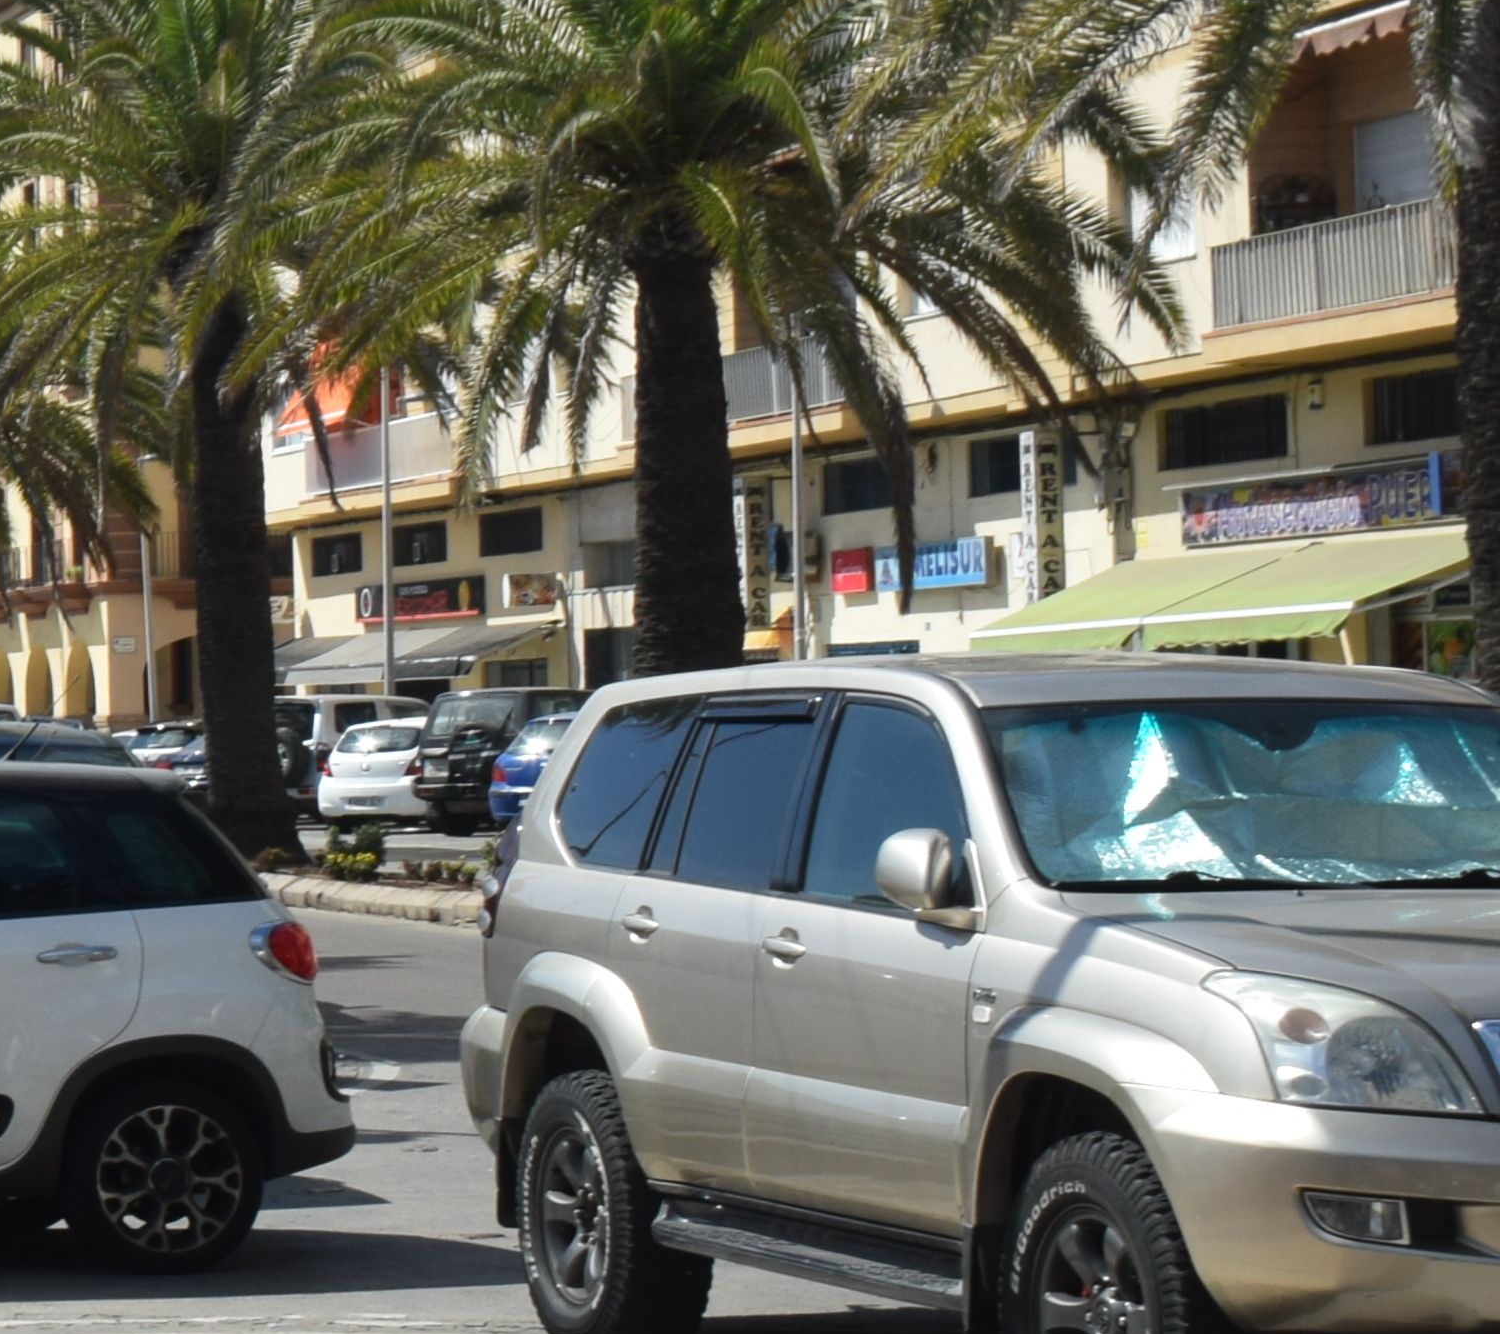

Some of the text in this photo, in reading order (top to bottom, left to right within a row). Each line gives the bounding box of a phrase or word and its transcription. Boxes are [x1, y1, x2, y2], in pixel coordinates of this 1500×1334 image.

[1040, 462, 1059, 524] RENT
[747, 503, 767, 626] RENT A CAR
[1042, 534, 1061, 548] A
[1009, 1179, 1087, 1294] BFGoodrich
